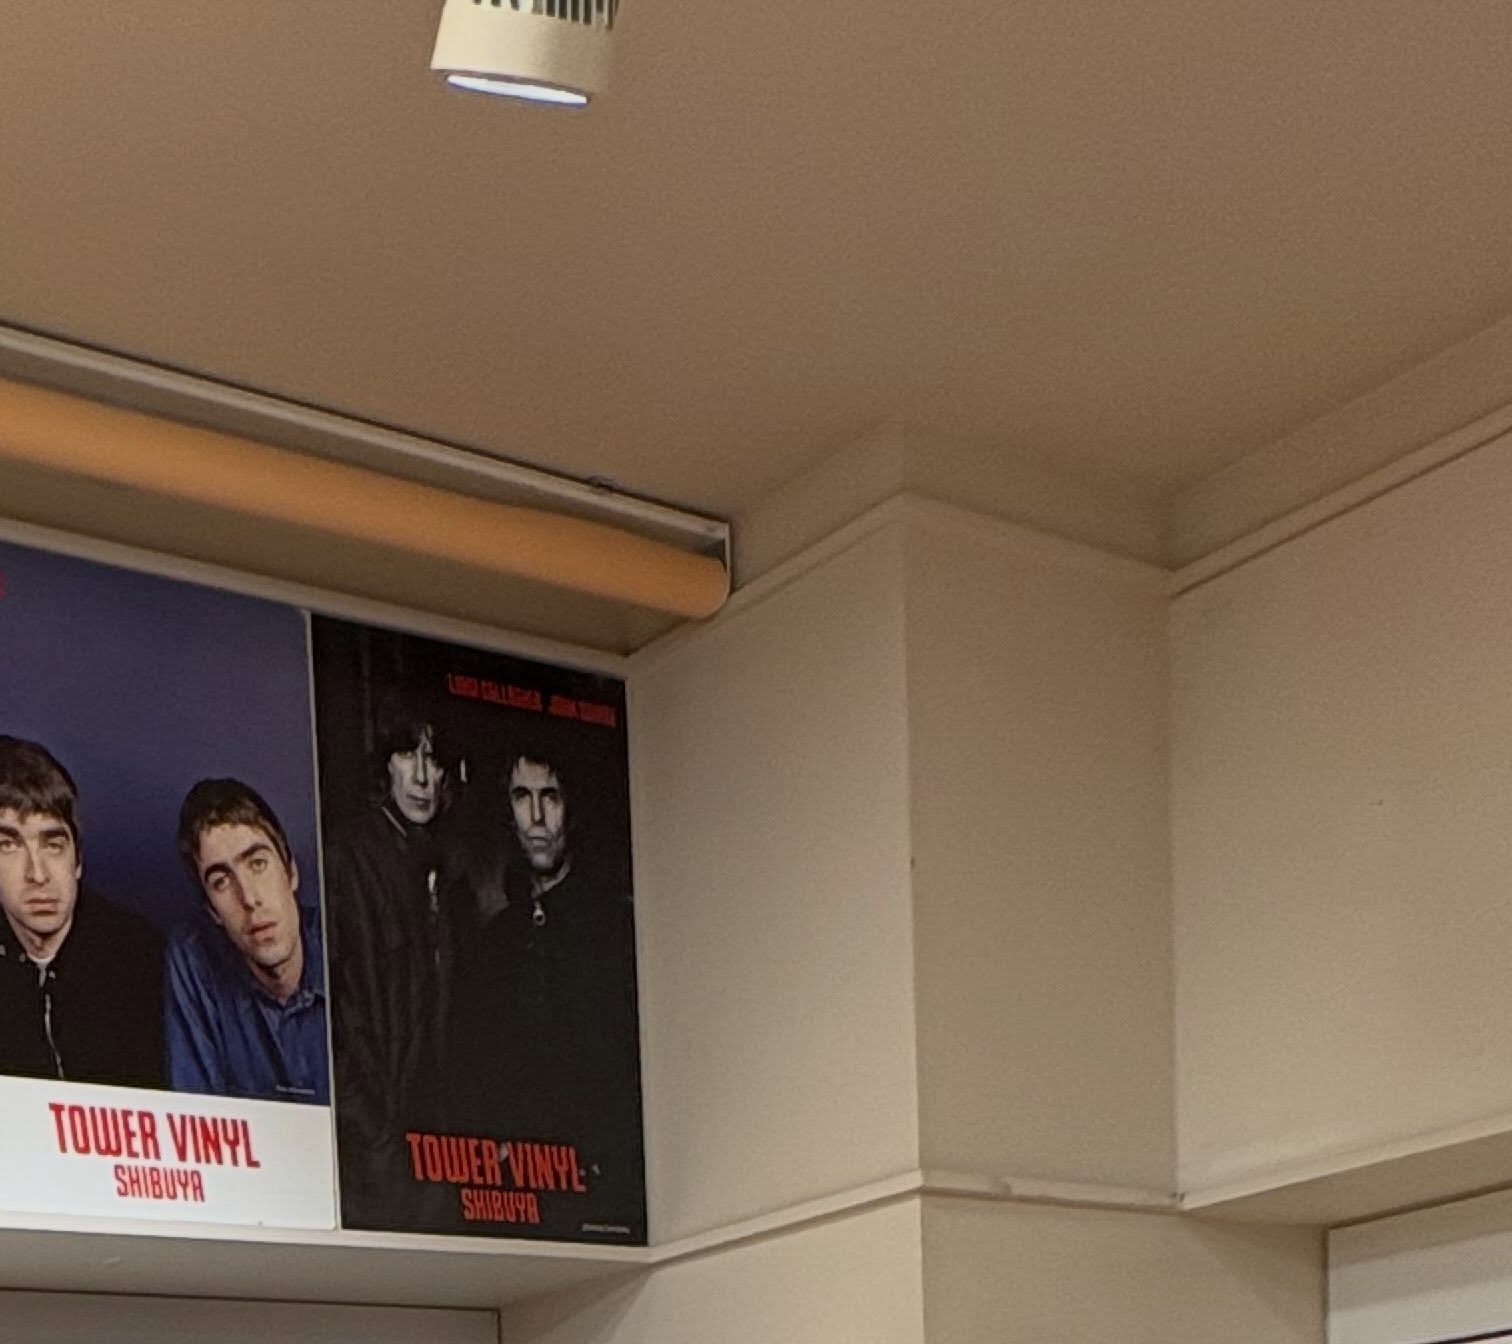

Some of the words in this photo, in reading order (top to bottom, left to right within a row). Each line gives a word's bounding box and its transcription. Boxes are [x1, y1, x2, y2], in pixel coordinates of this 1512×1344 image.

[48, 1102, 161, 1160] TOWER
[166, 1112, 261, 1169] VINYL
[113, 1164, 207, 1204] SHIBUYA
[405, 1132, 502, 1187] TOWER
[503, 1141, 586, 1193] VINYL
[459, 1187, 541, 1225] SHIBUYA
